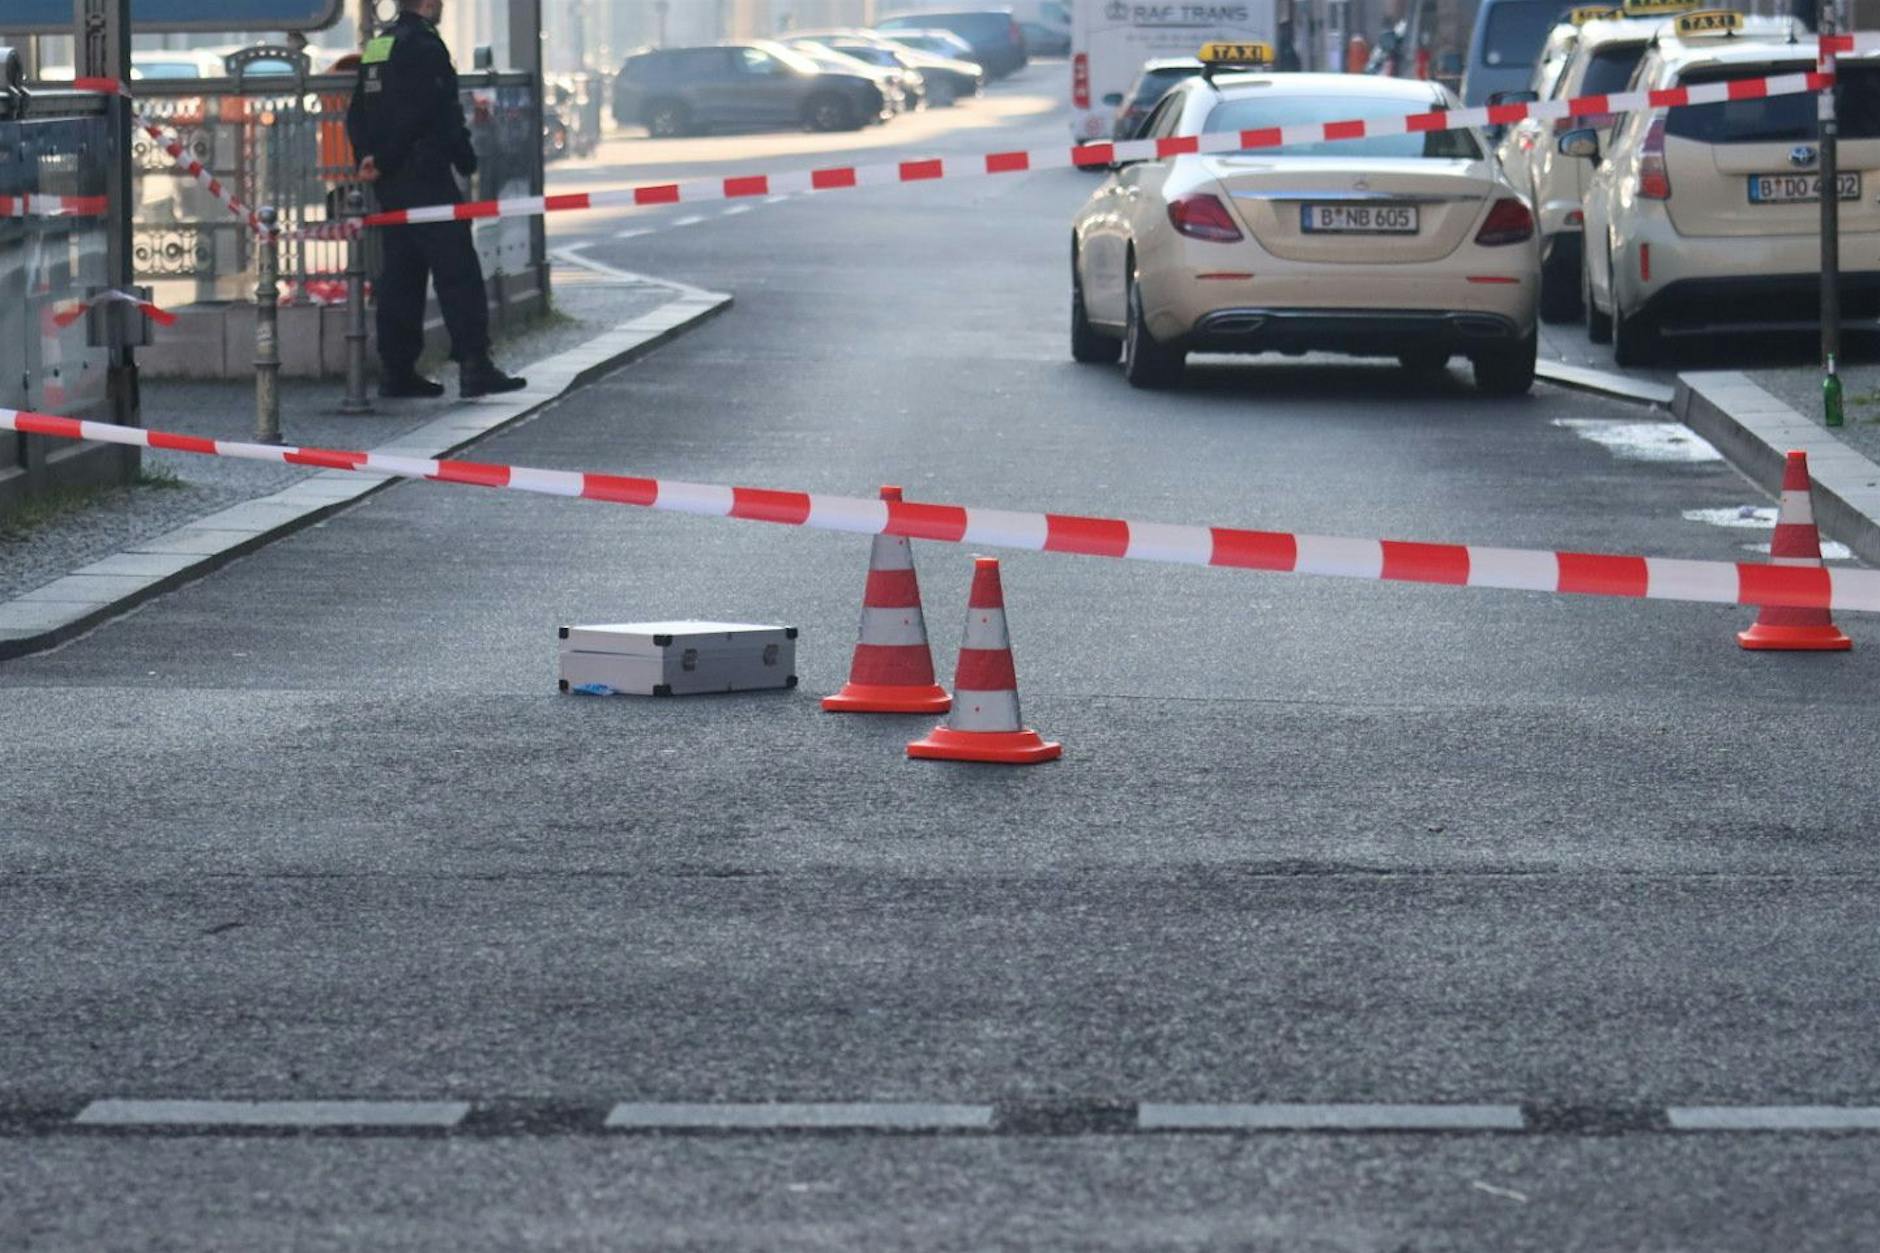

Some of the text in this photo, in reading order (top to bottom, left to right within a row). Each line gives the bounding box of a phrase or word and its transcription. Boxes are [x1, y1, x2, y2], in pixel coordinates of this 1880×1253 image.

[1181, 6, 1249, 21] TRANS
[1687, 14, 1728, 30] TAXI
[1214, 46, 1262, 60] TAXI
[1761, 180, 1772, 197] B
[1812, 176, 1856, 195] 402
[1321, 208, 1409, 226] B NB 605
